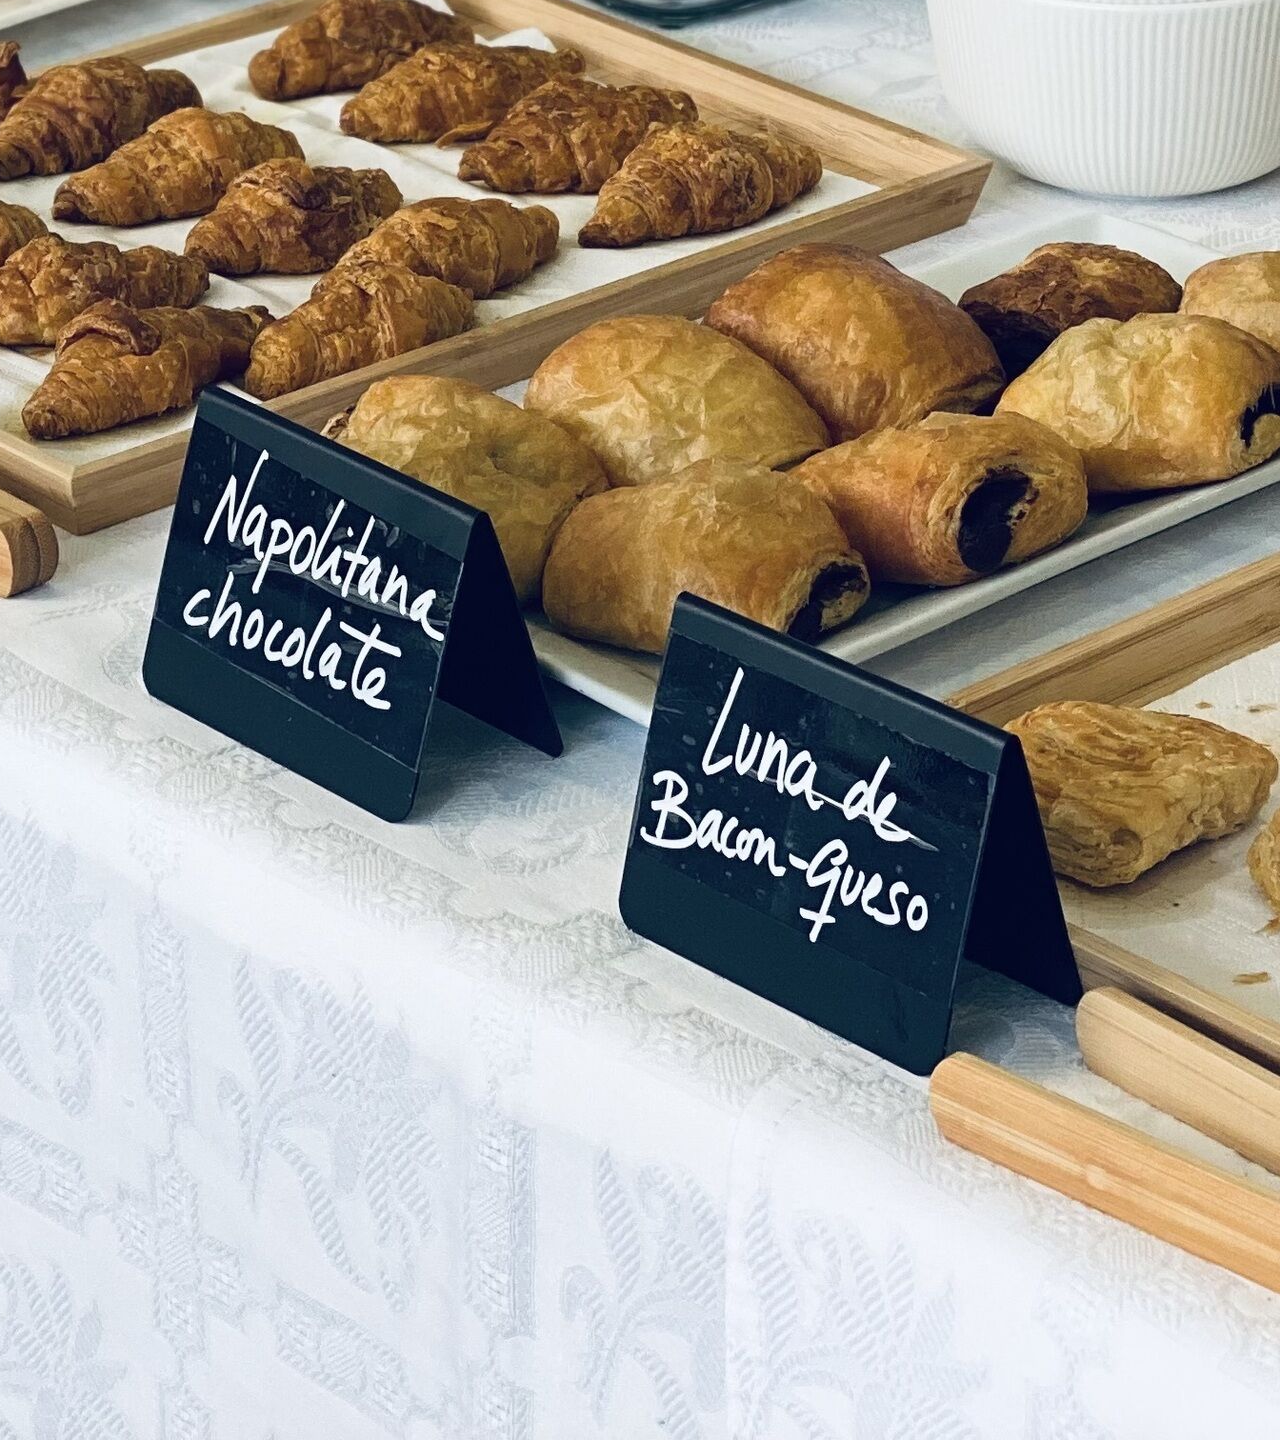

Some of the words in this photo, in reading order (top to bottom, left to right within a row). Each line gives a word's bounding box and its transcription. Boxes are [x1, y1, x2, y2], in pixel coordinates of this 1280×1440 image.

[203, 449, 445, 642] Napolitana
[183, 570, 402, 711] chocolate
[701, 667, 825, 810] Luna
[842, 755, 915, 842] de
